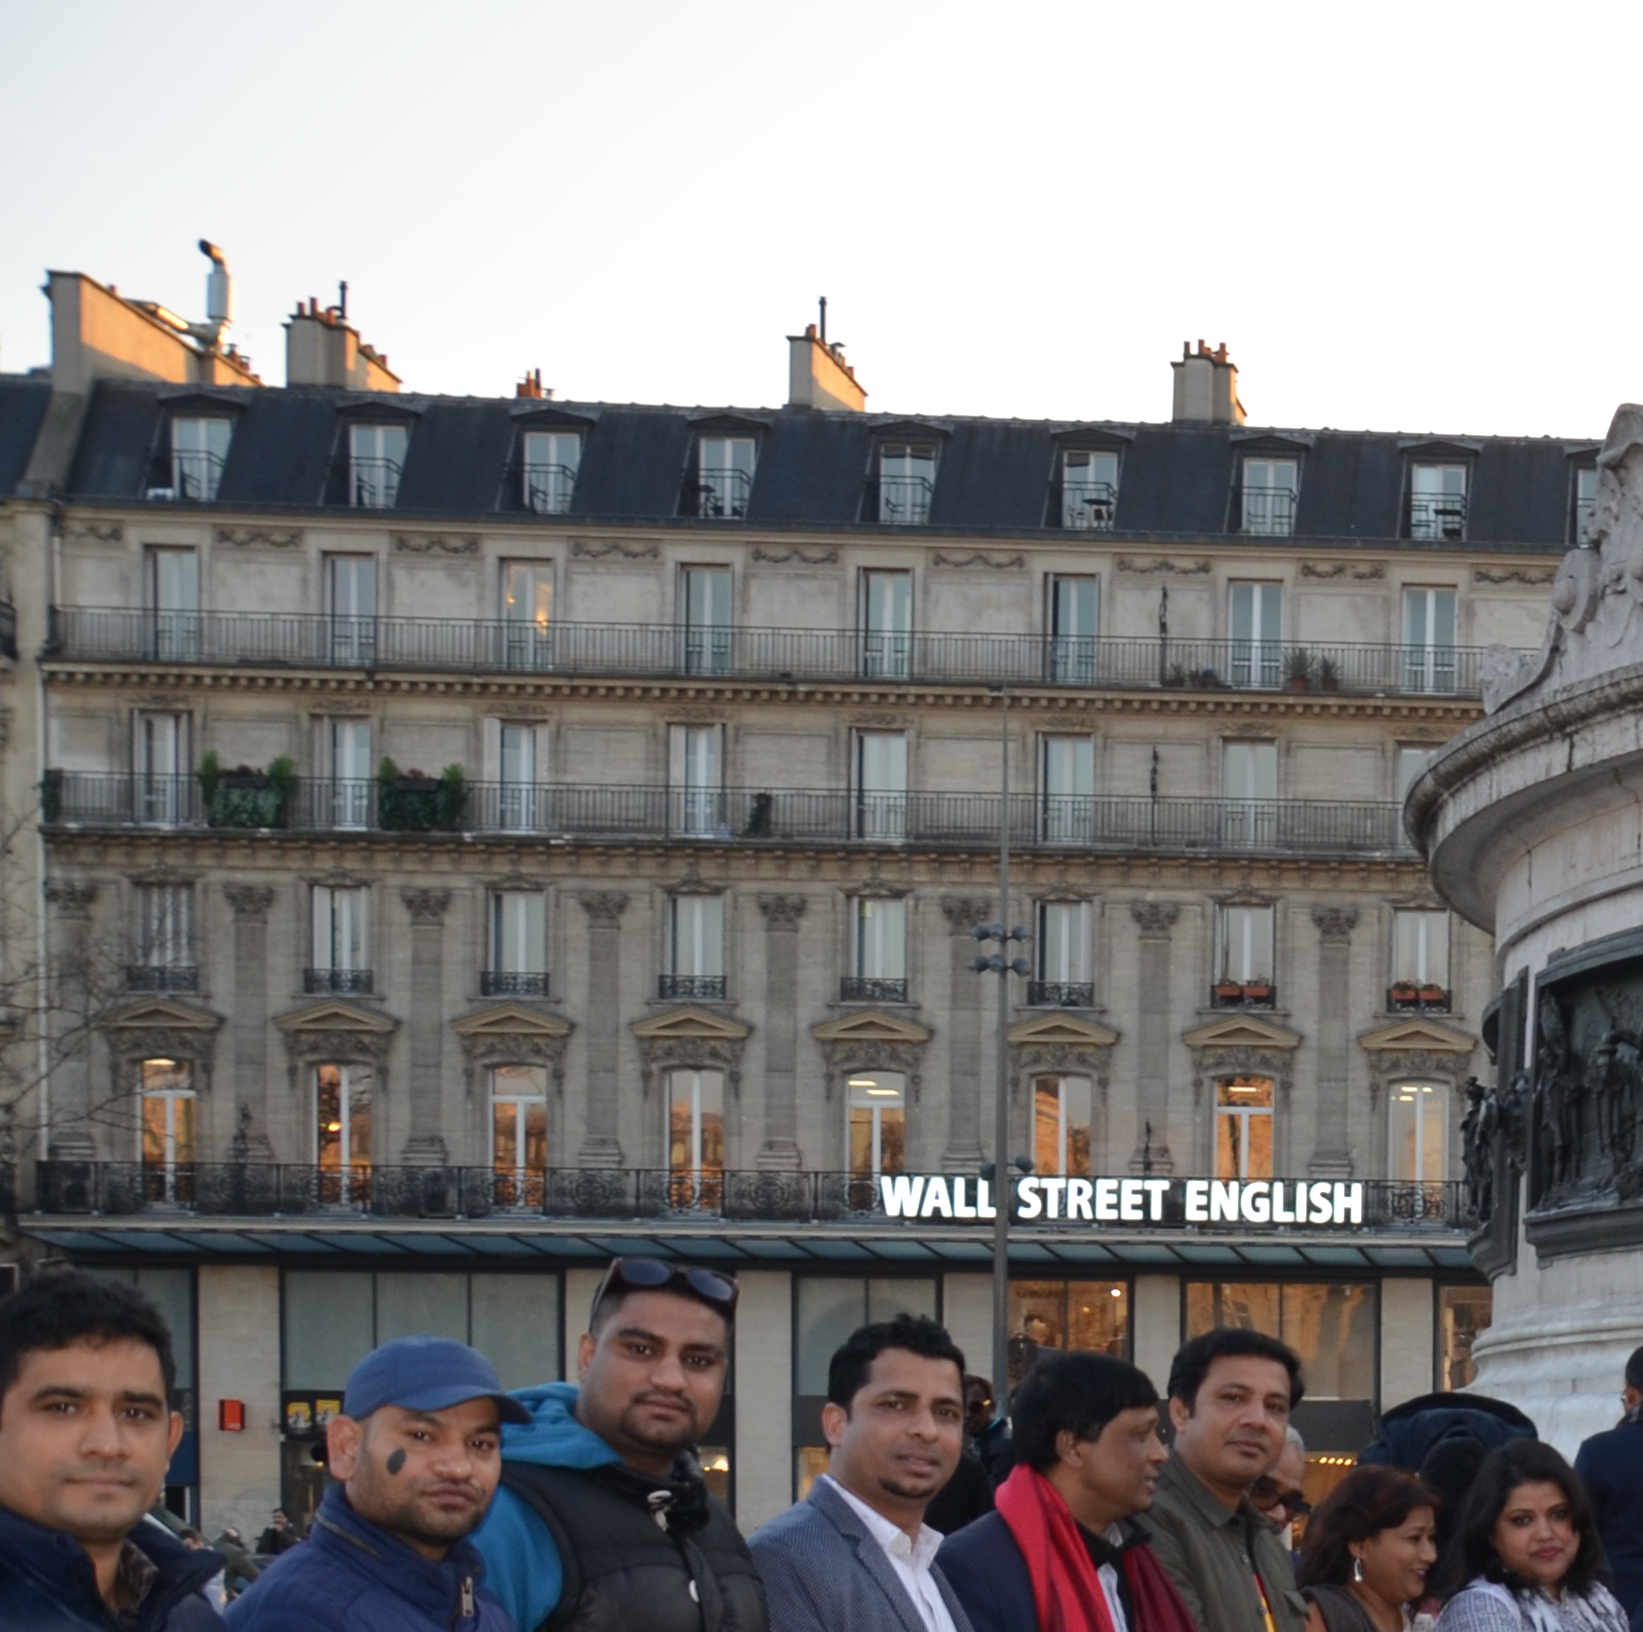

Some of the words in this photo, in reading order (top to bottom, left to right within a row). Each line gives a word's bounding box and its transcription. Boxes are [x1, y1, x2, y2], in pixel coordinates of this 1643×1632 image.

[880, 1175, 997, 1219] WALL
[1016, 1176, 1170, 1222] STREET
[1184, 1179, 1363, 1225] ENGLISH
